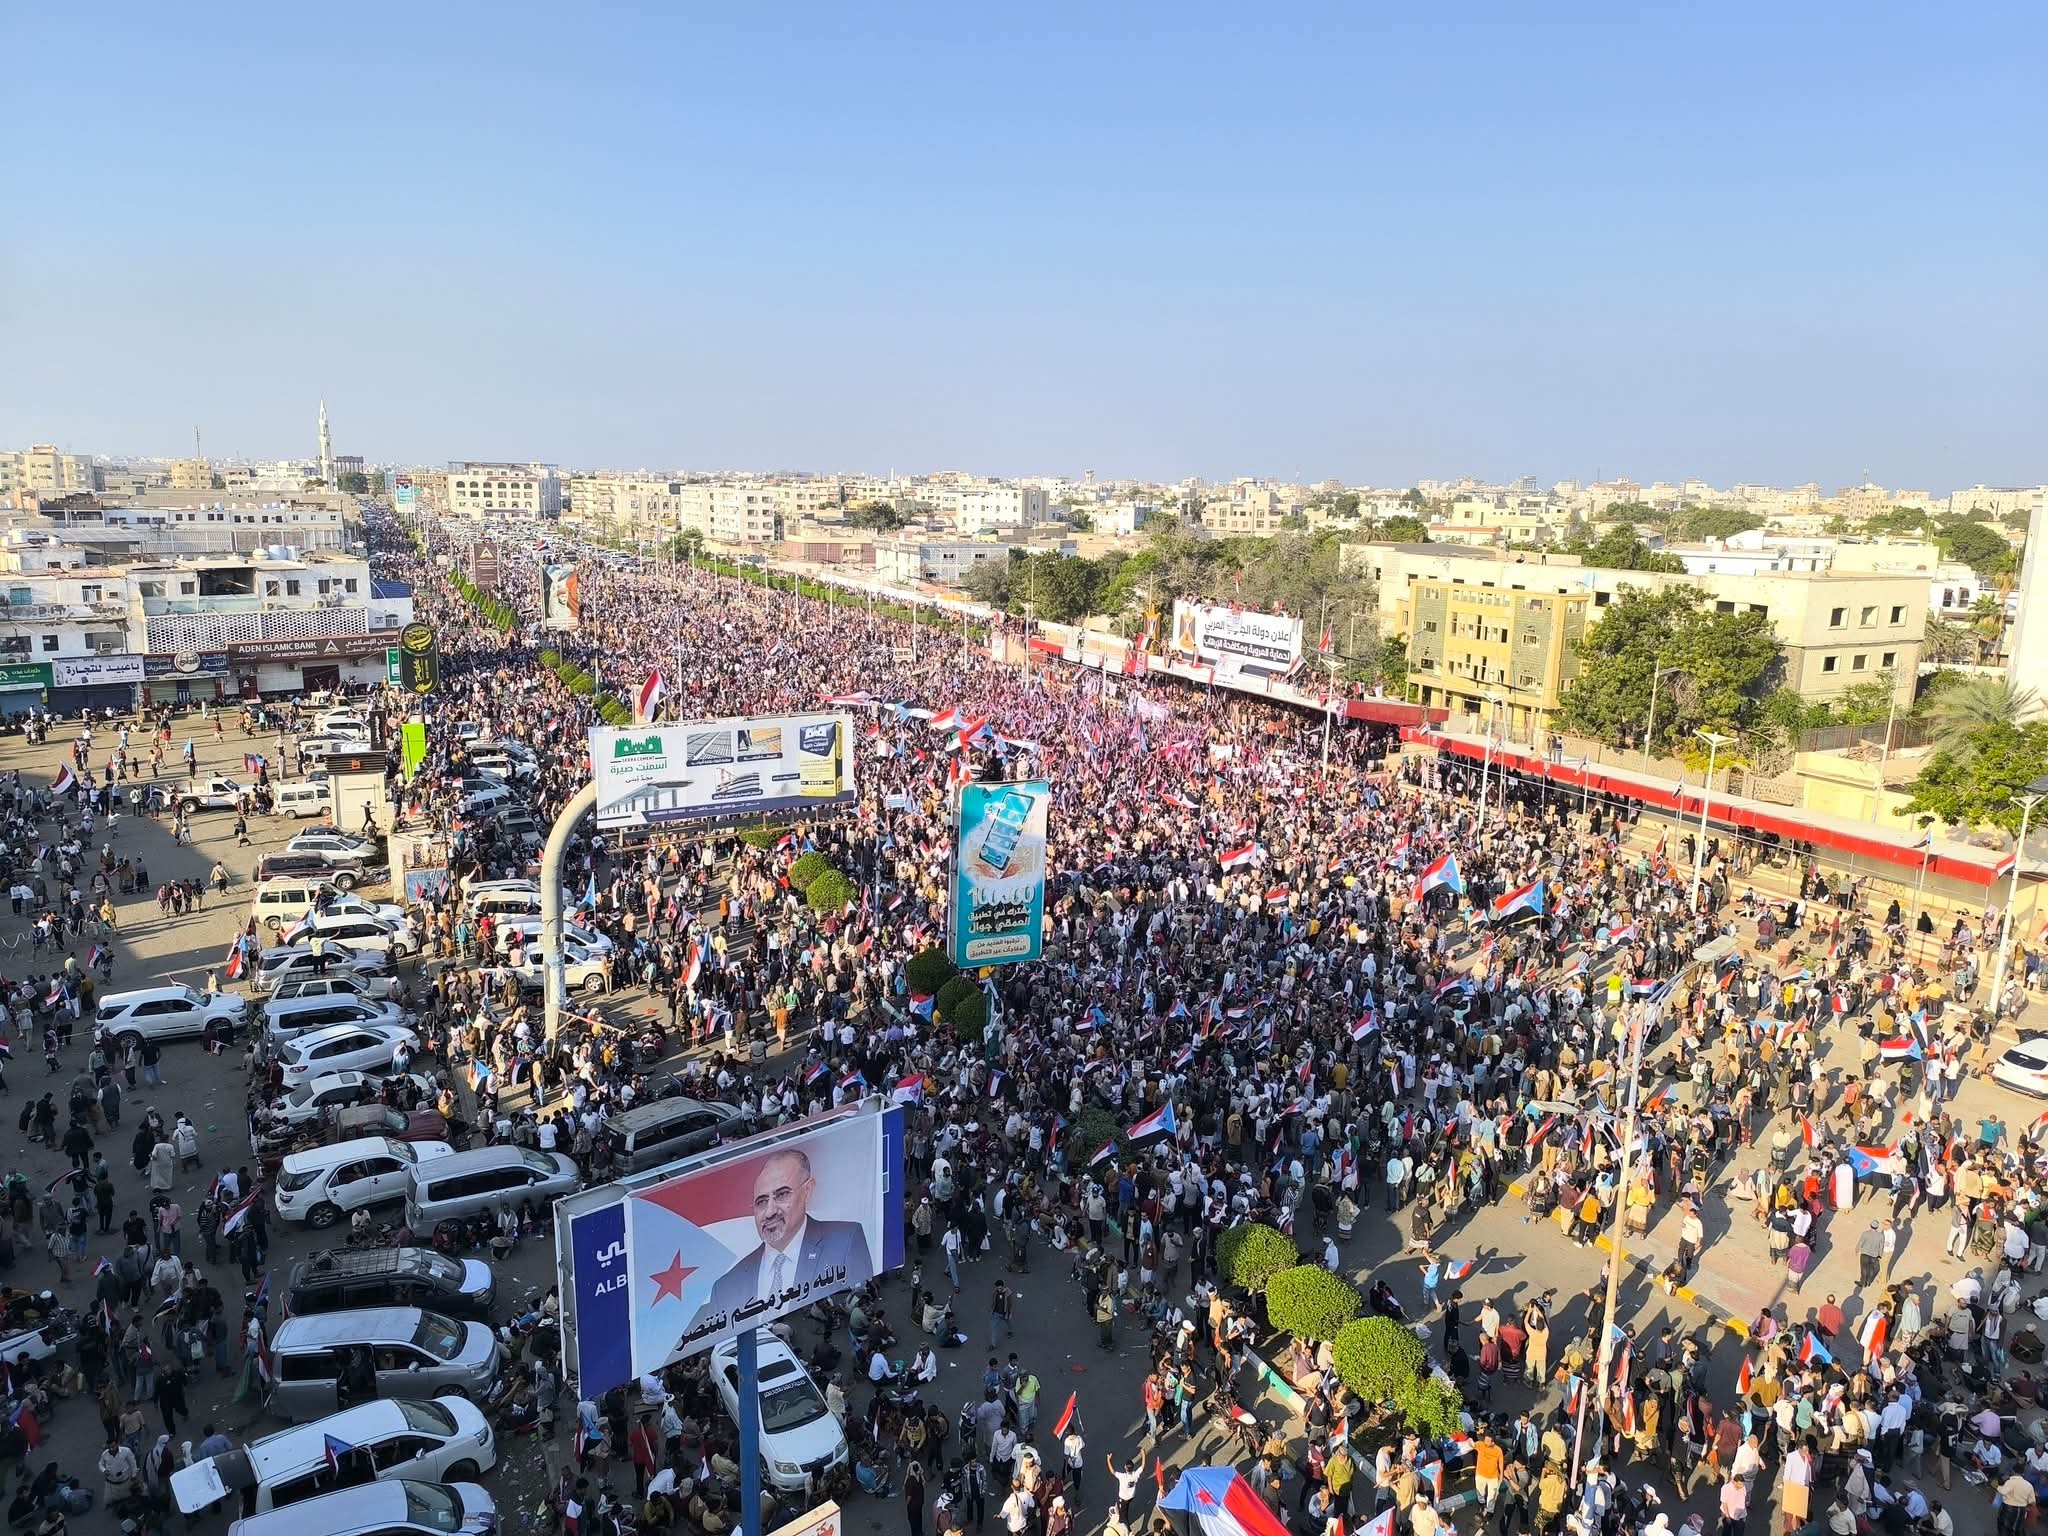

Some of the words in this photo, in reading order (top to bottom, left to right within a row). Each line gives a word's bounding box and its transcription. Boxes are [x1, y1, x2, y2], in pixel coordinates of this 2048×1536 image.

[1252, 625, 1270, 640] دولة
[239, 645, 262, 654] ADEN
[262, 642, 295, 652] ISLAMIC
[294, 641, 317, 650] BANK
[65, 664, 103, 677] للتجارة
[106, 663, 140, 674] باعبيد
[968, 921, 992, 934] جوال
[813, 1264, 847, 1288] بالله
[731, 1281, 810, 1329] وبعزمكم
[676, 1310, 727, 1352] ننتصر
